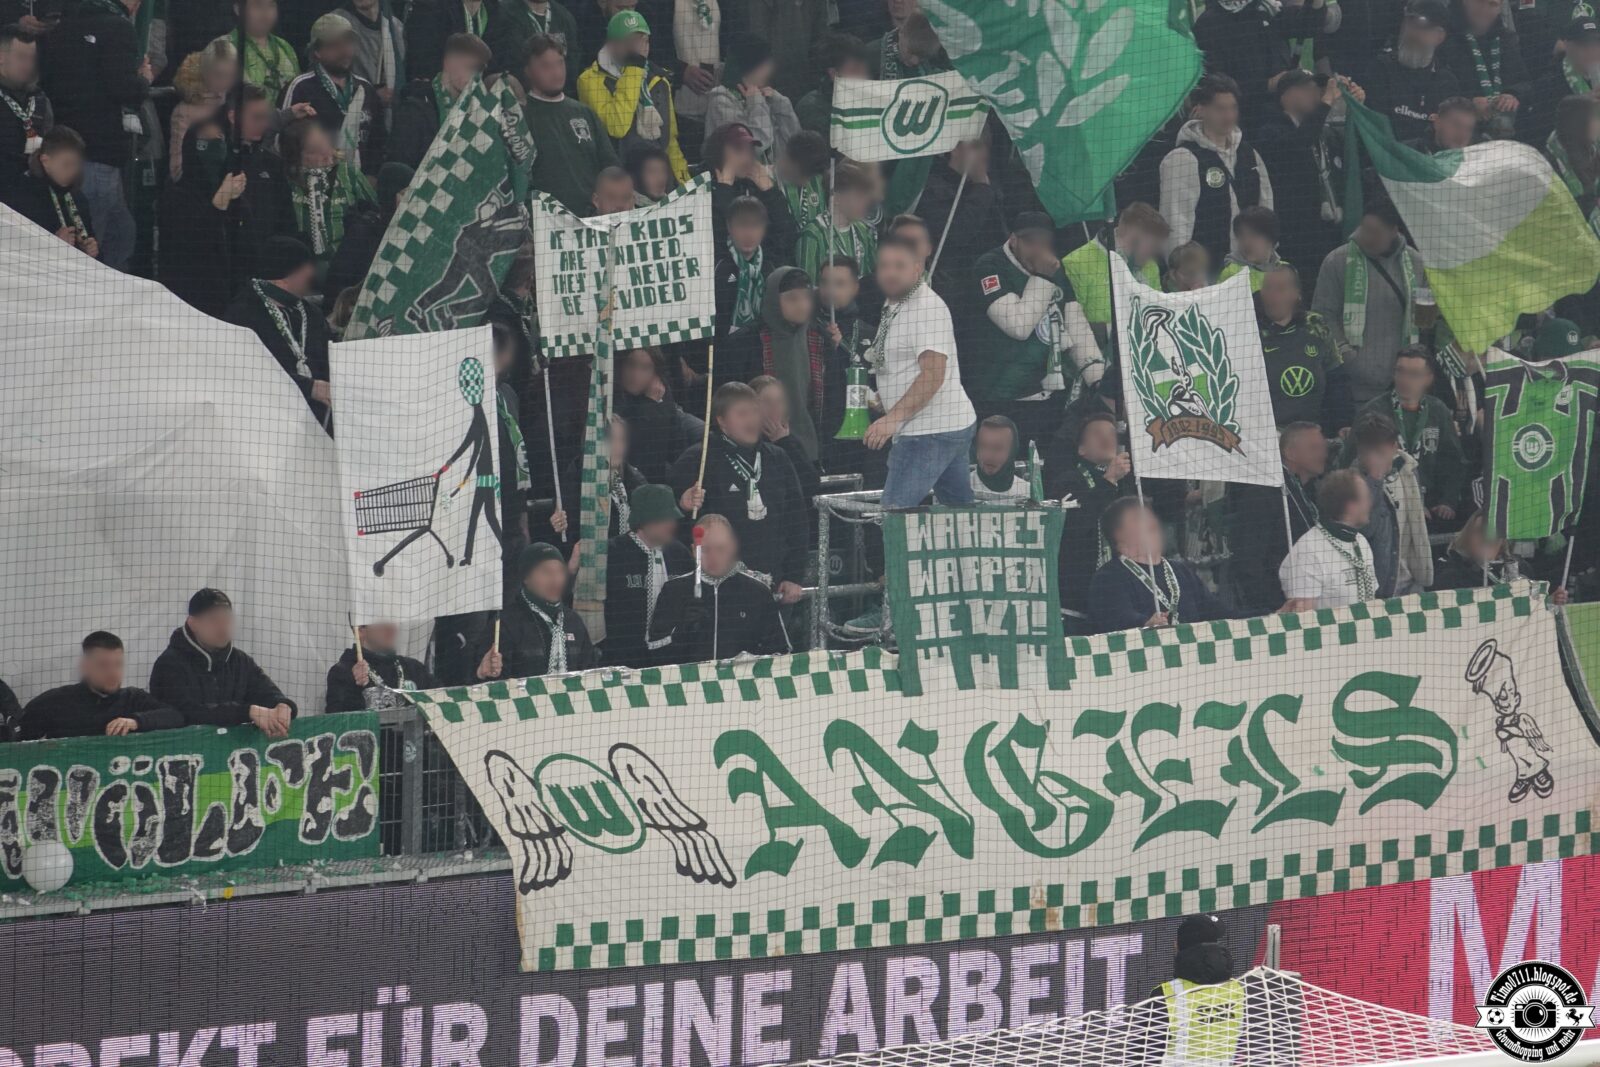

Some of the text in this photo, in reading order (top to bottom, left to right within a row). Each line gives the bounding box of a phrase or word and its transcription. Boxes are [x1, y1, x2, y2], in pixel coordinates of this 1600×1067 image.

[630, 214, 694, 242] KIDS
[560, 250, 588, 272] ARE
[628, 257, 700, 287] NEVER
[562, 295, 584, 316] BE
[905, 511, 1048, 552] WAHRES
[908, 556, 1047, 597] WAPPEN
[915, 599, 1047, 640] JETZT!
[713, 671, 1458, 880] ANGELS
[306, 986, 488, 1067] FÜR
[519, 970, 793, 1067] DEINE
[818, 932, 1143, 1058] ARBEIT
